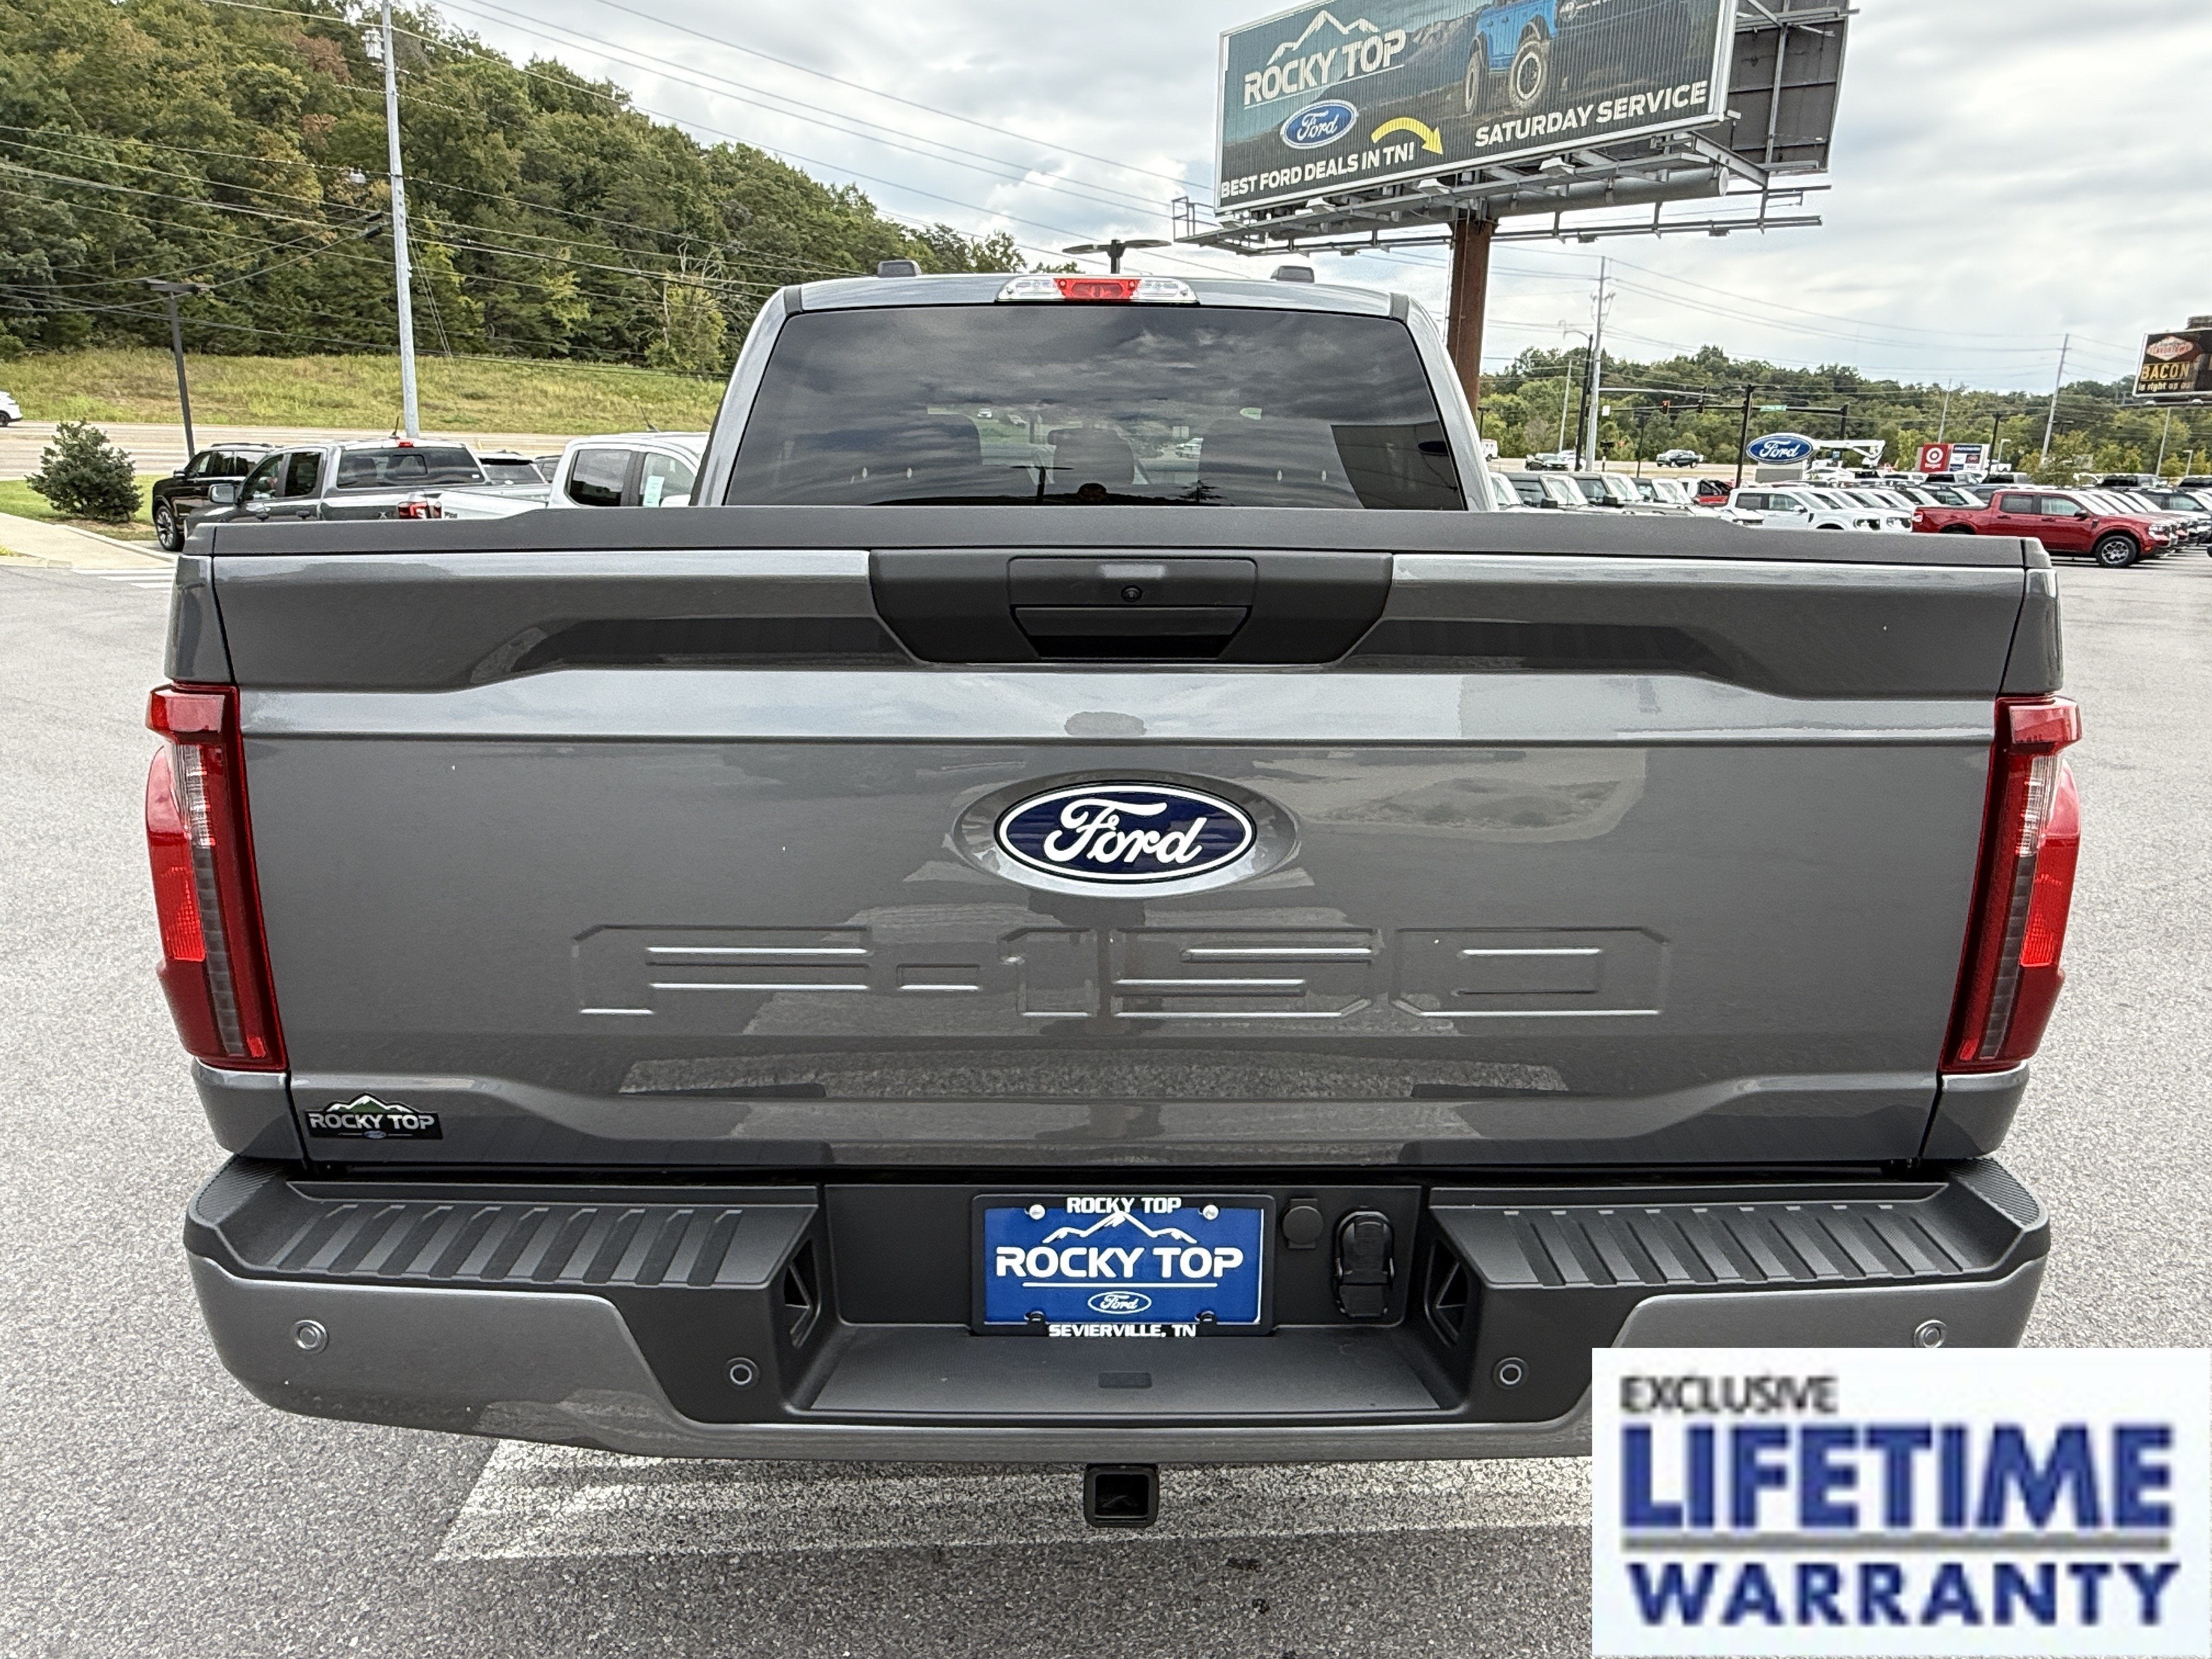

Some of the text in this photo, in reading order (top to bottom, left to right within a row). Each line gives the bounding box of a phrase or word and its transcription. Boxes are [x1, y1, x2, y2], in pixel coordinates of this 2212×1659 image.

[1244, 29, 1406, 105] ROCKY TOP
[1297, 110, 1340, 141] Ford
[1475, 80, 1708, 147] SATURDAY SERVICE
[1221, 142, 1415, 198] BEST FORD DEALS IN TN!
[2141, 363, 2190, 379] BACON
[1759, 440, 1801, 458] Ford
[1043, 798, 1207, 864] Ford
[571, 924, 1671, 1017] F-150
[308, 1113, 435, 1130] ROCKY TOP
[1066, 1197, 1182, 1214] ROCKY TOP
[996, 1246, 1244, 1278] ROCKY TOP
[1100, 1295, 1139, 1309] Ford
[1172, 1324, 1196, 1337] TN
